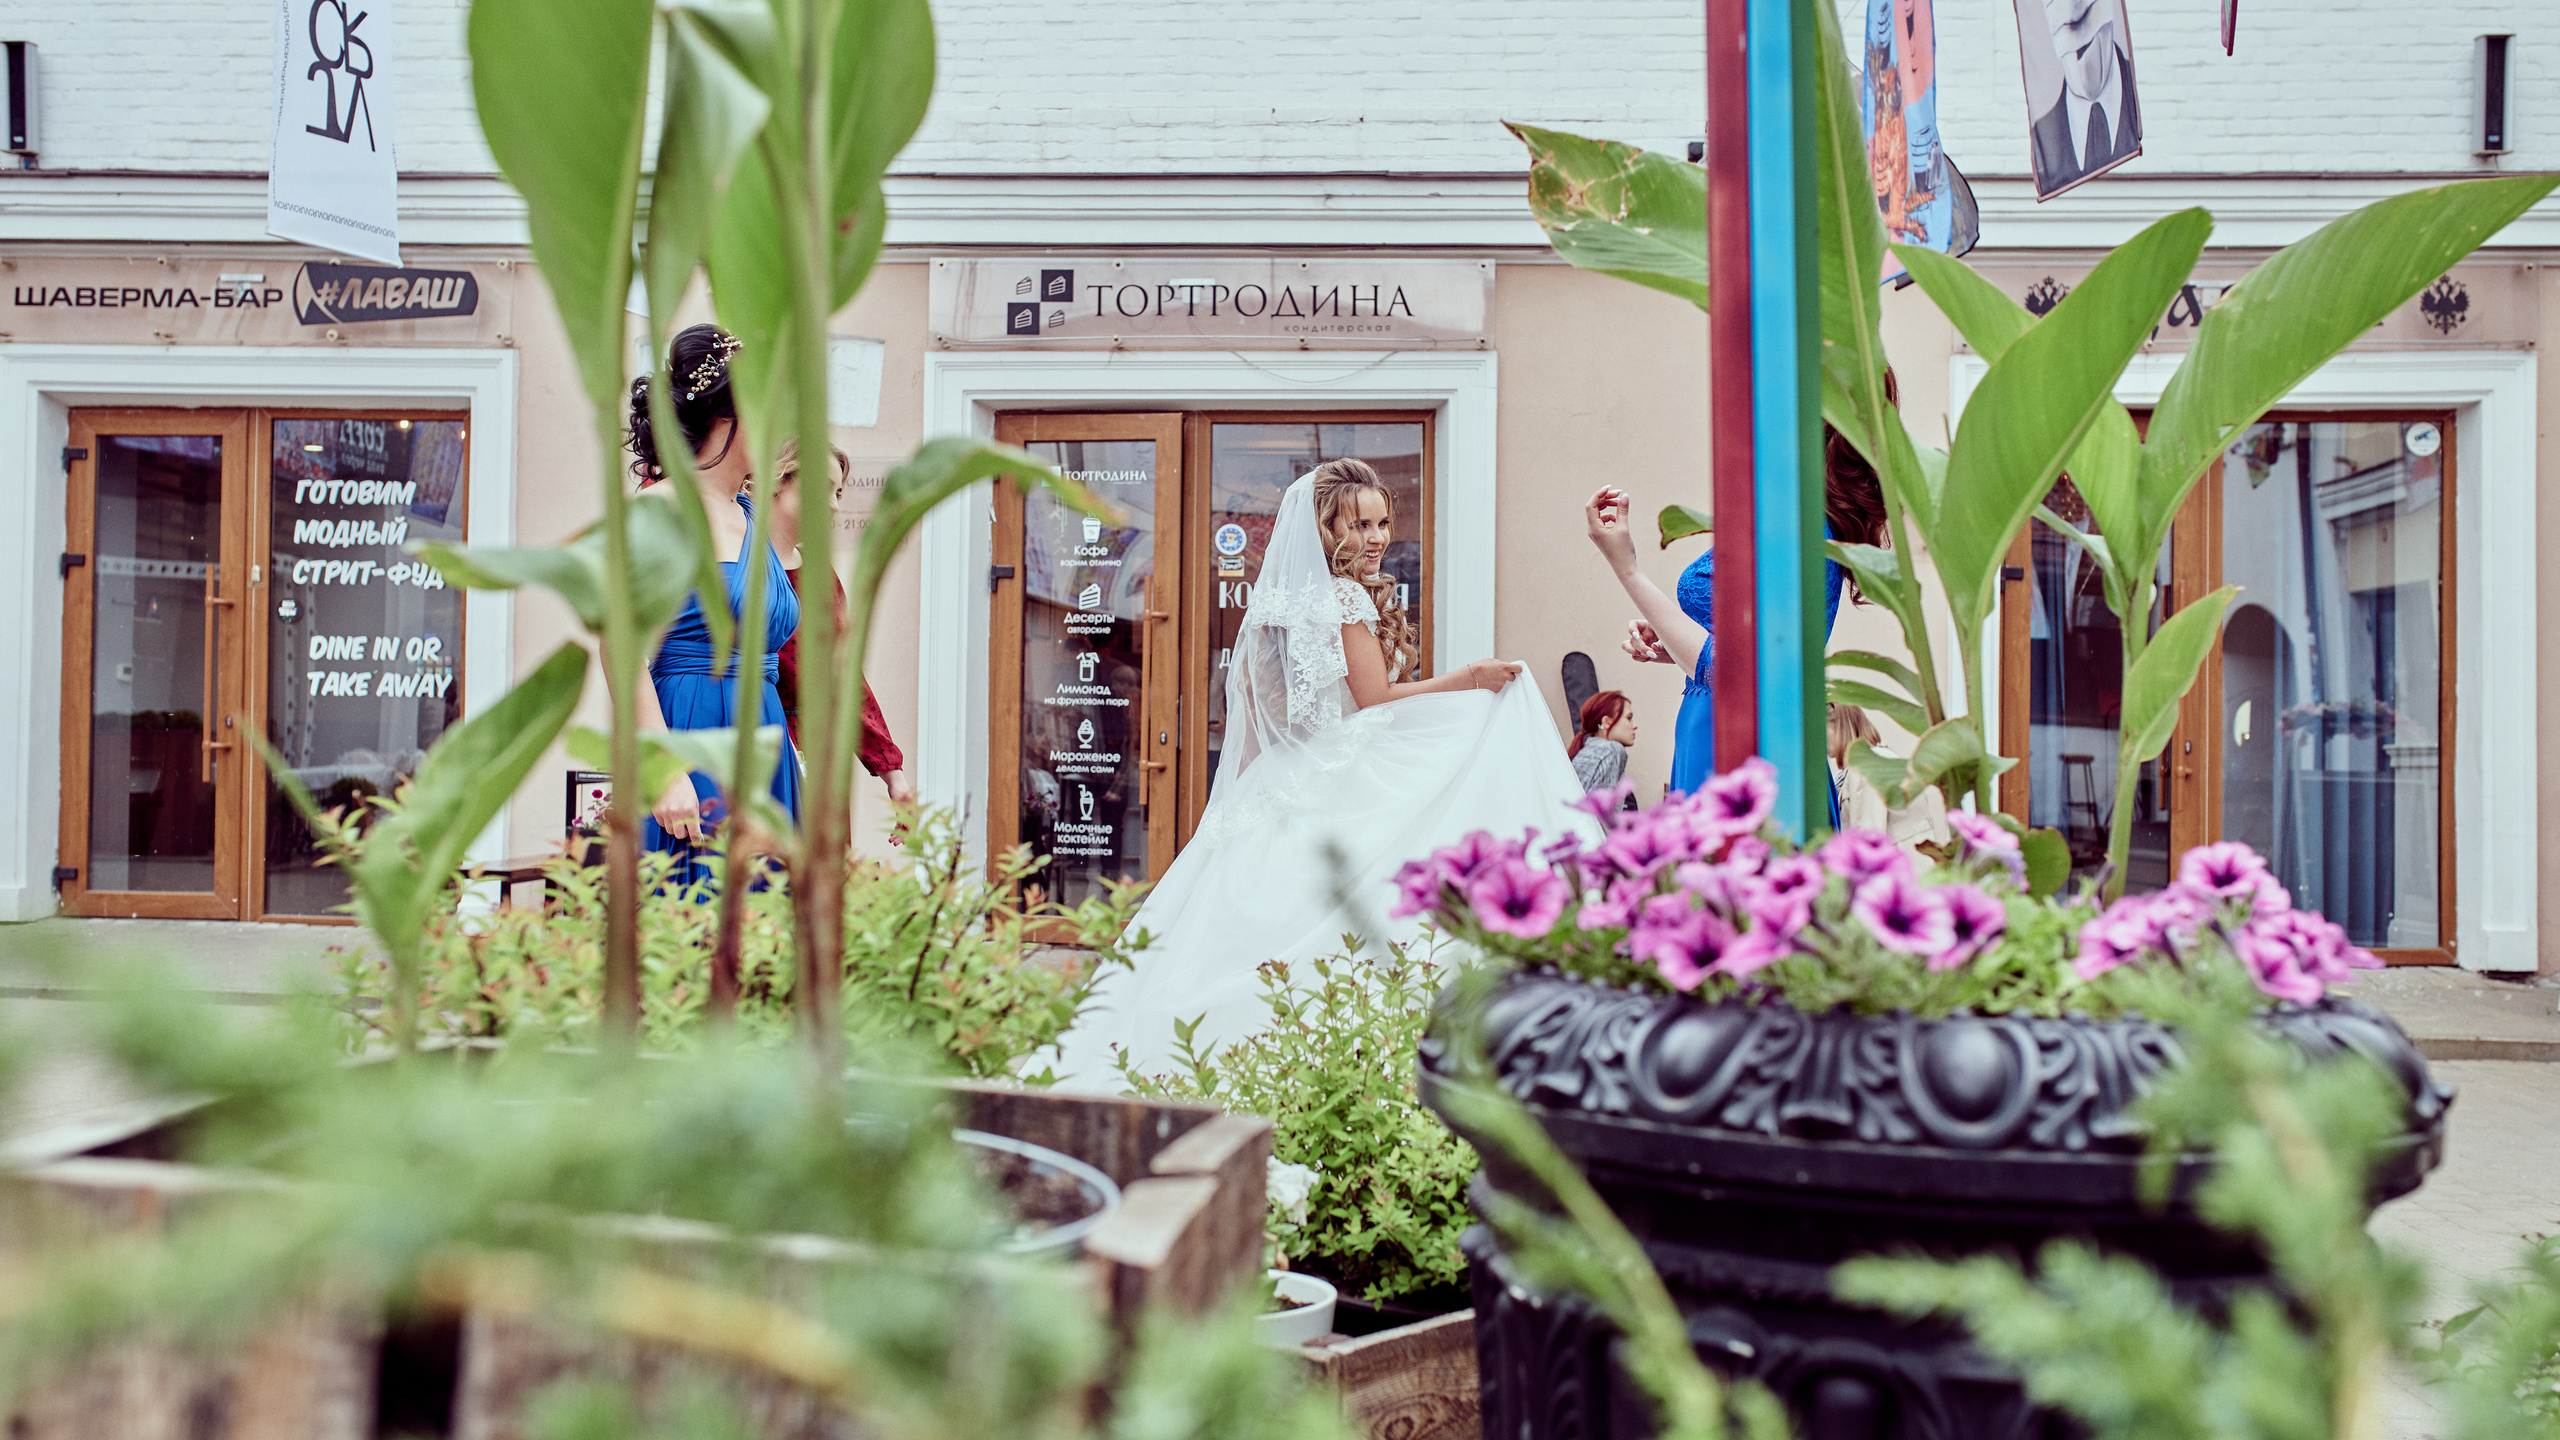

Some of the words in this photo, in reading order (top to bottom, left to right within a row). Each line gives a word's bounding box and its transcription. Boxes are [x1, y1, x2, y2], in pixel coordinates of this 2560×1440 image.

[14, 285, 284, 308] ШАВЕРМА-БАР
[317, 277, 466, 309] #ЛАВАШ
[1086, 284, 1414, 318] ТОРТРОДИНА
[1284, 324, 1391, 333] кондитерская
[1064, 471, 1147, 482] ТОРТРОДИНА
[295, 479, 417, 506] ГОТОВИМ
[293, 516, 408, 548] МОДНЫЙ
[1074, 545, 1108, 557] Кофе
[1060, 559, 1088, 567] варим
[1089, 559, 1122, 567] отлично
[292, 559, 446, 590] СТРИТ-ФУД
[1063, 612, 1115, 625] Десерты
[1067, 626, 1111, 635] авторские
[309, 635, 368, 661] DINE
[372, 636, 401, 661] IN
[405, 636, 443, 661] OR
[307, 671, 372, 697] TAKE
[376, 672, 453, 699] AWAY
[1057, 683, 1111, 696] Лимонад
[1044, 697, 1055, 705] на
[1057, 696, 1105, 707] фруктовом
[1106, 698, 1130, 708] пюре
[1050, 750, 1121, 763] Мороженое
[1055, 765, 1089, 773] делаем
[1091, 765, 1114, 773] сами
[1054, 822, 1113, 834] Молочные
[1057, 834, 1109, 845] коктейли
[1053, 847, 1075, 855] всем
[1076, 847, 1113, 856] нравятся
